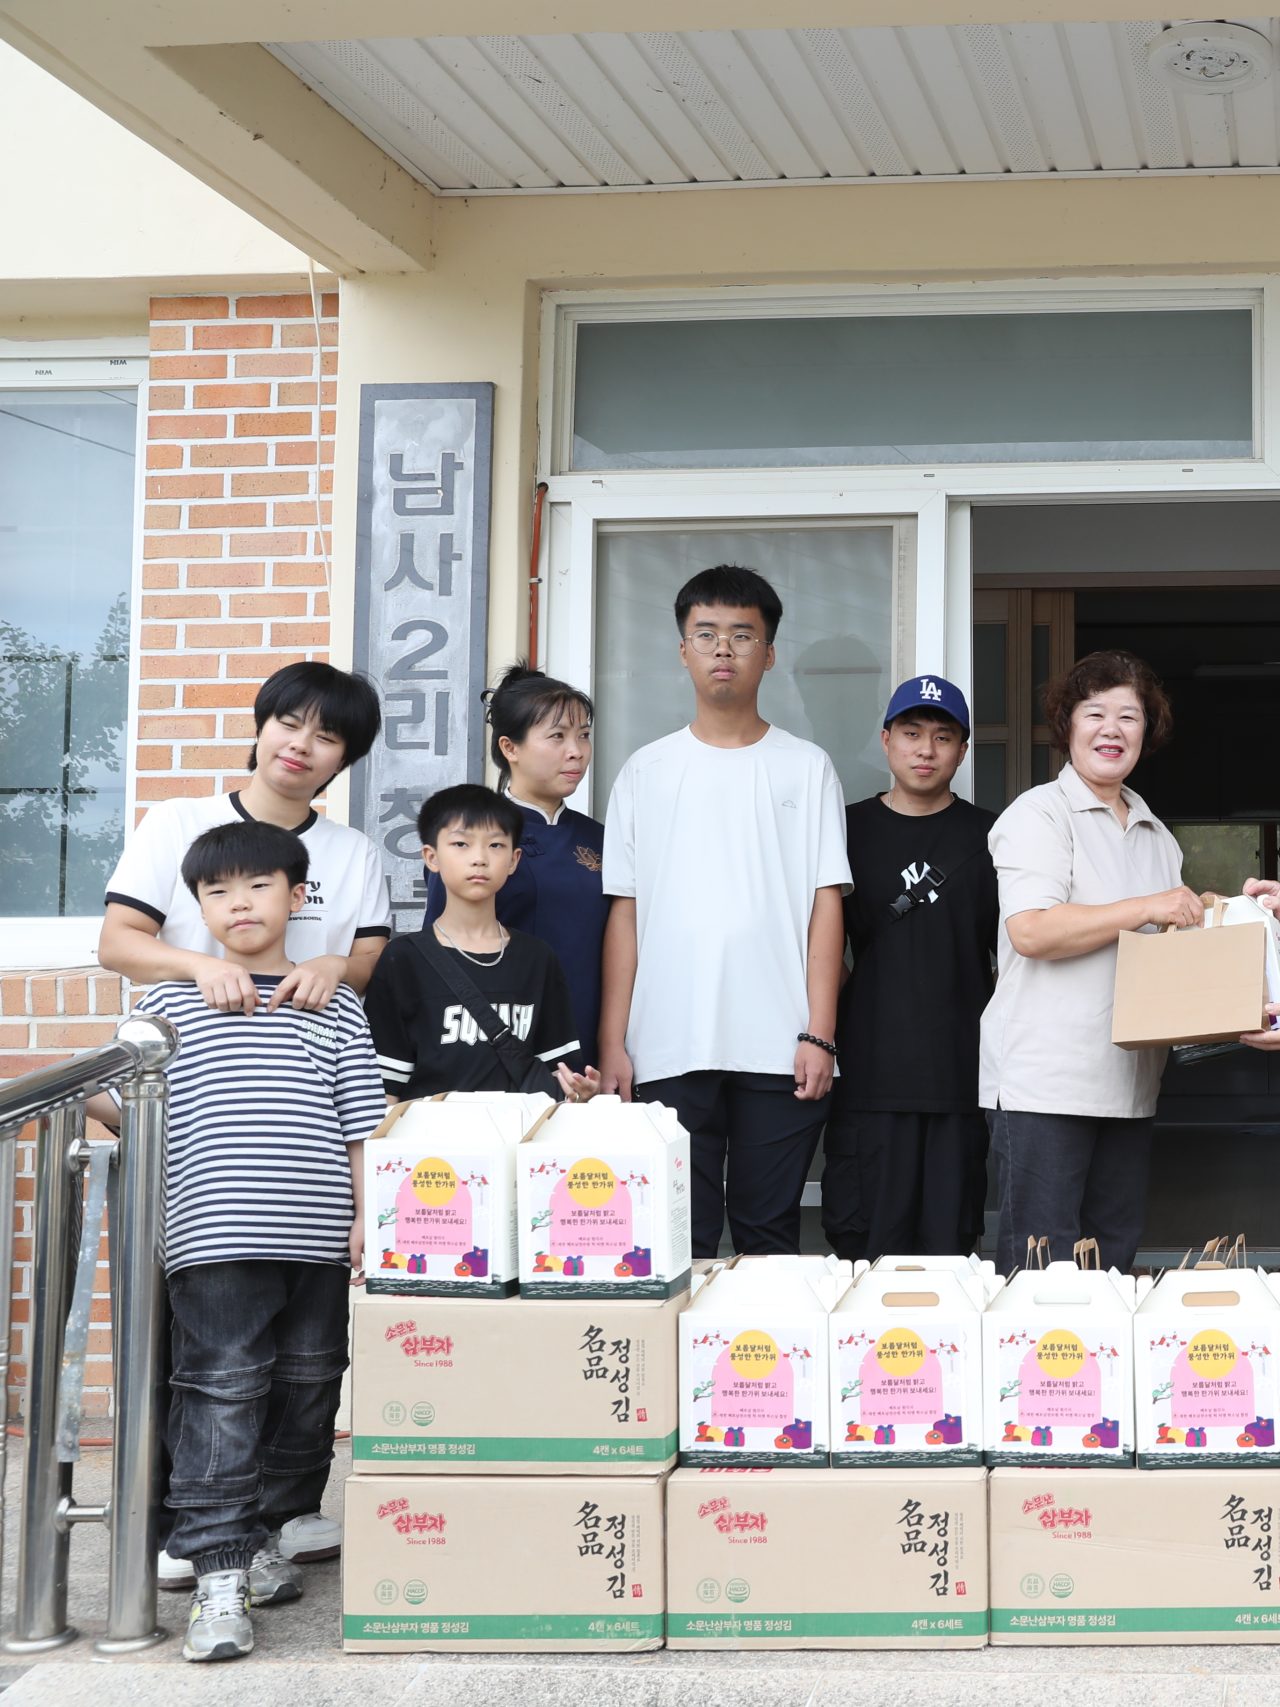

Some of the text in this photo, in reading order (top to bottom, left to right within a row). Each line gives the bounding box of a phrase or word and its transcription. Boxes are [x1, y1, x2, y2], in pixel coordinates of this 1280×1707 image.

[919, 678, 942, 701] LA
[413, 1180, 432, 1188] 풍성한
[385, 1320, 416, 1341] 소문난
[401, 1336, 454, 1357] 삼부자
[578, 1325, 609, 1380] 名品
[877, 1350, 923, 1359] 풍성한 한가위
[609, 1338, 630, 1422] 정성김
[372, 1444, 476, 1455] 소문난삼부자 명품 정성김
[593, 1445, 609, 1455] 4캔
[619, 1446, 645, 1455] 6세트
[377, 1497, 409, 1519] 소문난
[698, 1497, 730, 1518] 소문난
[1022, 1493, 1055, 1514] 소문난
[393, 1513, 446, 1535] 삼부자
[574, 1501, 604, 1556] 名品
[714, 1512, 768, 1534] 삼부자
[897, 1499, 927, 1554] 名品
[1038, 1509, 1091, 1530] 삼부자
[1220, 1494, 1250, 1549] 名品
[728, 1536, 767, 1544] Since 1988
[1250, 1507, 1273, 1590] 정성김
[604, 1514, 626, 1599] 정성김
[928, 1511, 950, 1596] 정성김
[363, 1622, 469, 1634] 소문난삼부자 명품 정성김
[588, 1622, 604, 1632] 4캔
[614, 1622, 640, 1632] 6세트
[686, 1620, 792, 1631] 소문난삼부자 명품 정성김
[911, 1620, 928, 1630] 4캔
[938, 1619, 963, 1630] 6세트
[1010, 1615, 1116, 1626] 소문난삼부자 명품 정성김
[1235, 1614, 1251, 1624] 4캔
